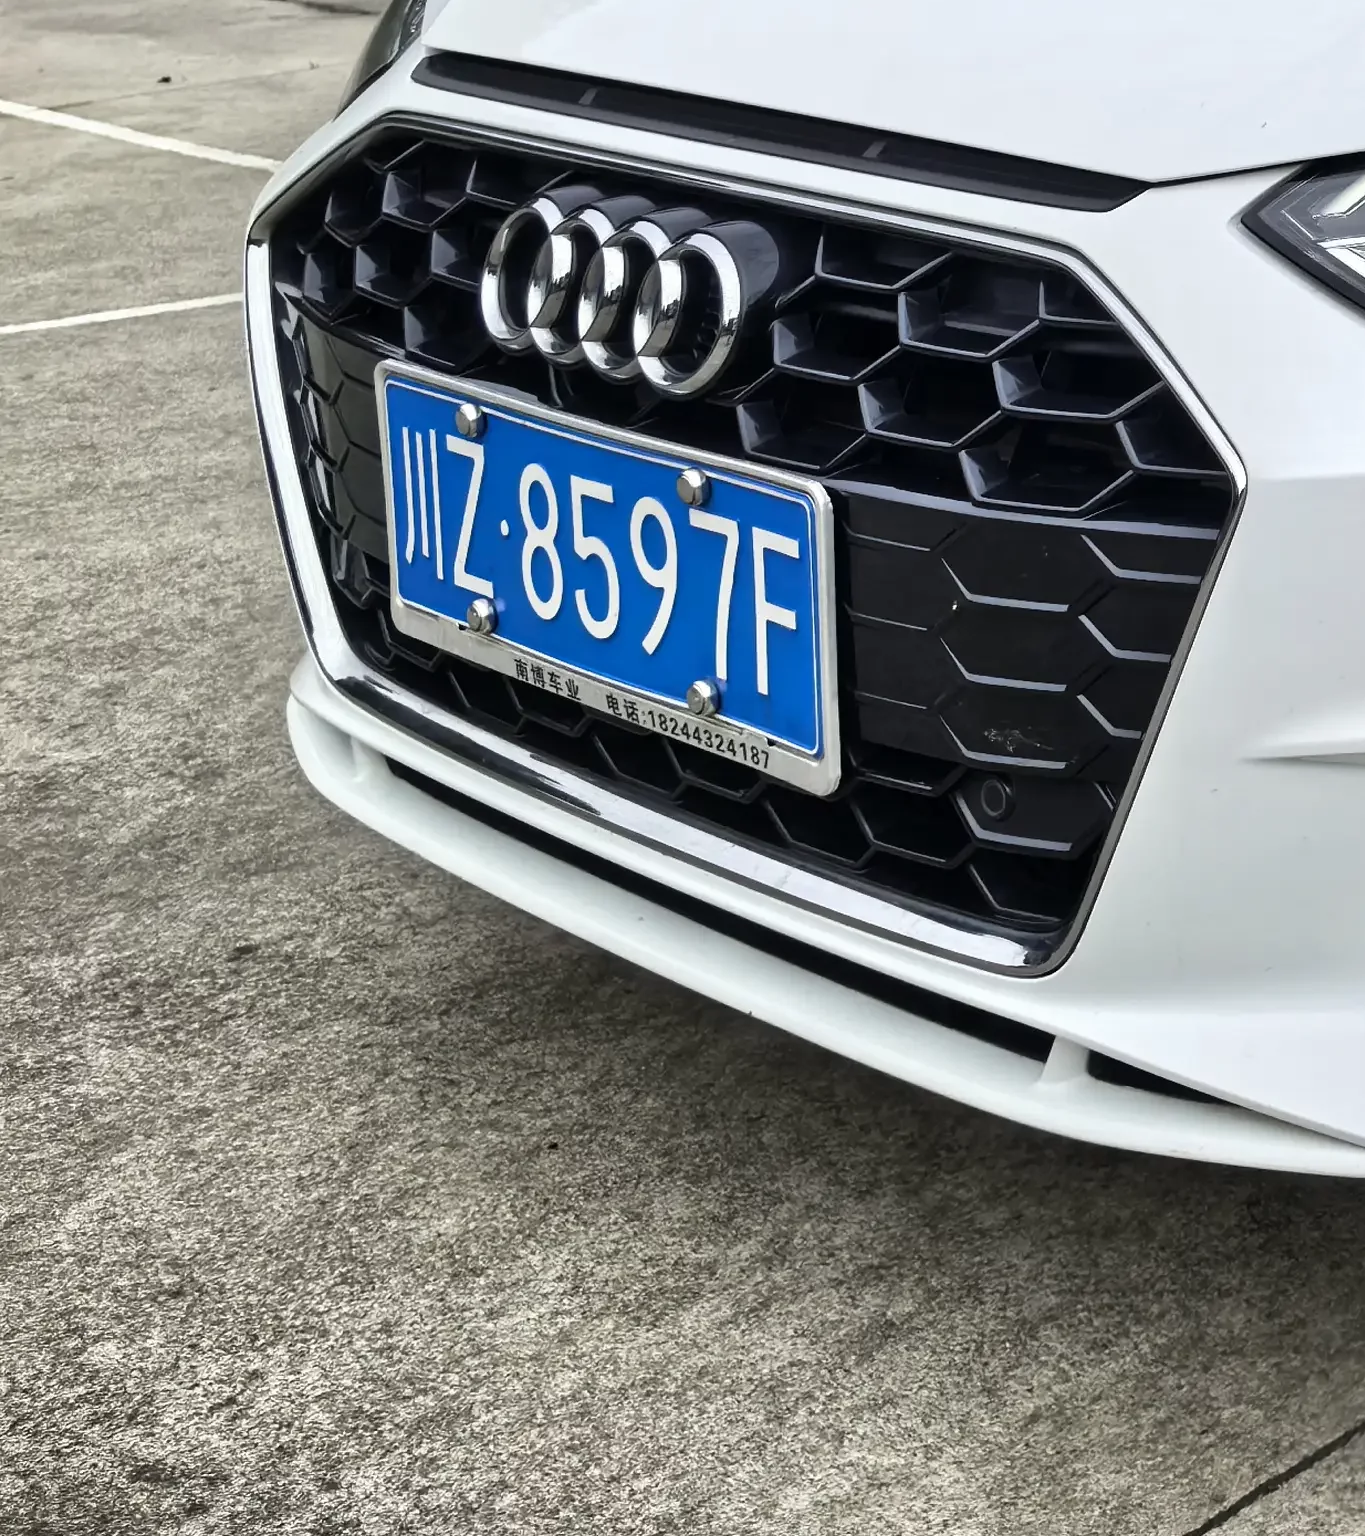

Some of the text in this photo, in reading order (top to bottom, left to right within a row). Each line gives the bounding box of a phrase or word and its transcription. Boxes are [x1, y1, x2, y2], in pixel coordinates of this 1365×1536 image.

[402, 425, 800, 696] 川Z·8597F
[513, 658, 582, 702] 南博车业
